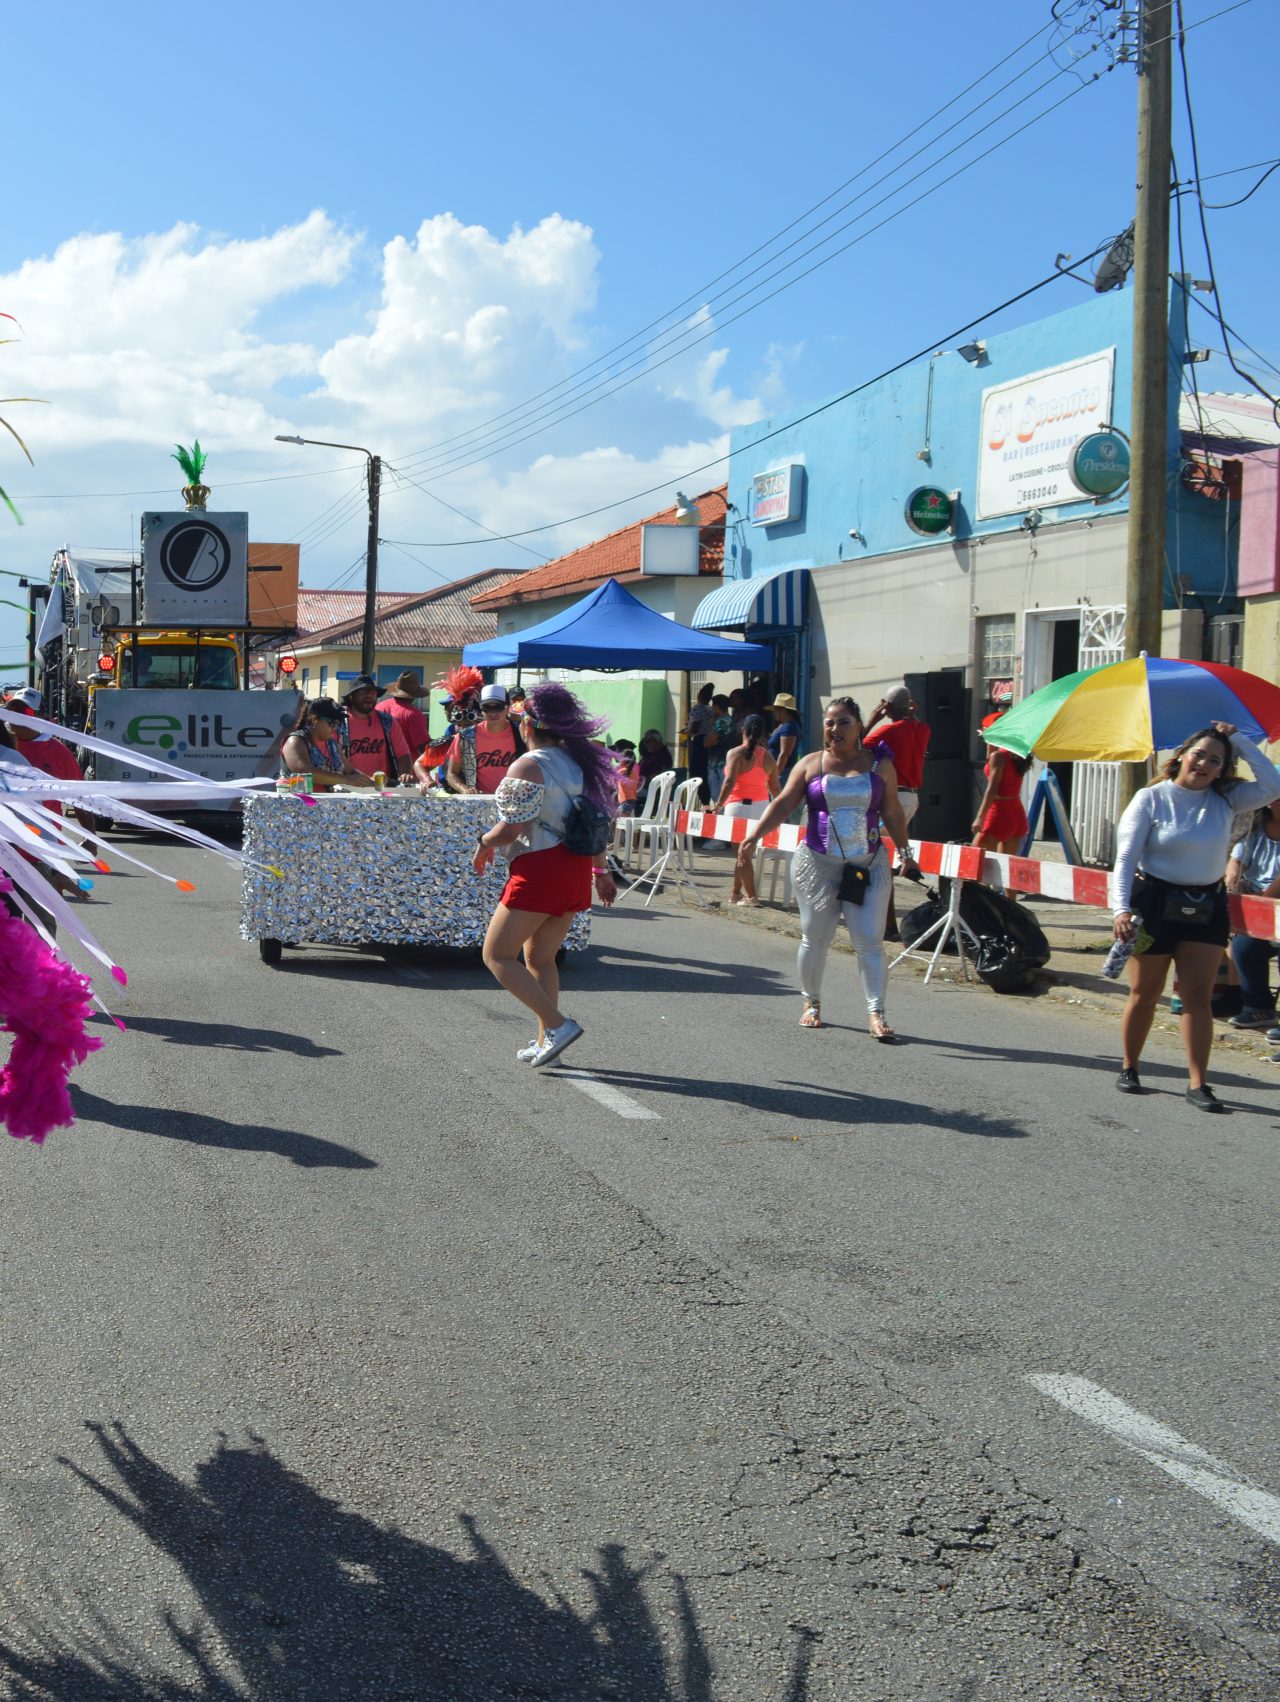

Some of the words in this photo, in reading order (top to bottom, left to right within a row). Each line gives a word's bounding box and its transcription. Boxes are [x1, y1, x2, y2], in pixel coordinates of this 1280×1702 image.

[1003, 449, 1019, 462] BAR
[1024, 434, 1078, 457] RESTAURANT
[1022, 484, 1058, 501] 5663040
[913, 510, 950, 520] Heineken
[349, 737, 385, 755] Chill
[475, 749, 518, 769] Chill
[122, 771, 283, 779] BUERIA
